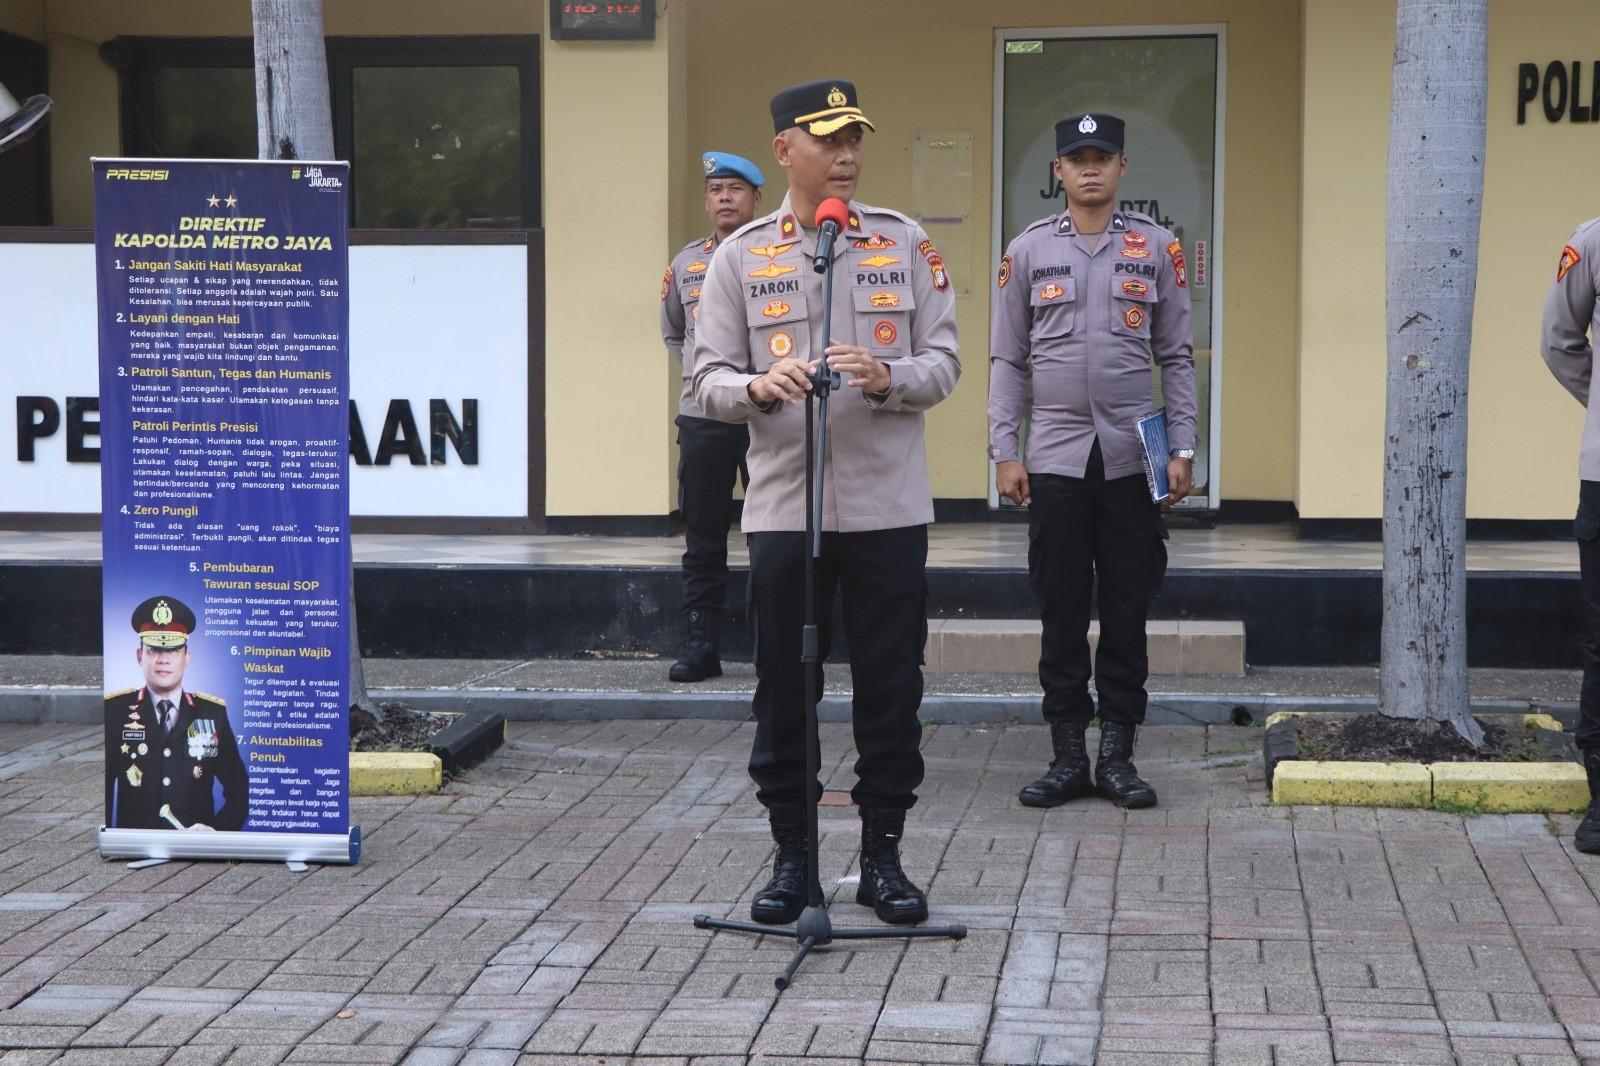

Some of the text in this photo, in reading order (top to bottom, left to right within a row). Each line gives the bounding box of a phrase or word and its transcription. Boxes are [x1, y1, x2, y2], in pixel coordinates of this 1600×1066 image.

[106, 169, 169, 180] PRESISI
[304, 166, 322, 178] JAGA
[179, 216, 266, 231] DIREKTIF
[114, 233, 332, 250] KAPOLDA METRO JAYA
[114, 259, 302, 274] 1. Jangan Sakiti Hati Masyarakat
[1032, 264, 1070, 280] JONATHAN
[1114, 262, 1156, 277] POLRI
[128, 275, 154, 284] Setiap
[205, 276, 226, 285] sikap
[231, 278, 250, 286] yang
[856, 272, 905, 285] POLRI
[176, 287, 202, 296] Setiap
[204, 288, 237, 296] anggota
[269, 288, 293, 297] wajah
[750, 280, 798, 298] ZAROKI
[232, 298, 283, 308] kepercayaan
[116, 312, 239, 326] 2. Layani dengan Hati
[130, 330, 178, 338] Kedepankan
[178, 342, 224, 350] masyarakat
[257, 342, 279, 351] objek
[183, 352, 204, 361] wajib
[224, 353, 255, 362] lindungi
[117, 366, 331, 380] 3. Patroli Santun, Tegas dan Humanis
[242, 385, 288, 394] pendekatan
[271, 397, 313, 406] ketegasan
[316, 398, 339, 406] tanpa
[132, 420, 258, 432] Patroli Perintis Presisi
[305, 438, 339, 447] proaktif-
[174, 458, 198, 467] dialog
[207, 459, 237, 467] dengan
[280, 460, 300, 468] peka
[233, 470, 257, 478] patuhi
[309, 471, 339, 480] Jangan
[133, 479, 208, 487] bertindak/bercanda
[291, 482, 339, 490] kehormatan
[120, 504, 198, 518] 4. Zero Pungli
[317, 535, 339, 544] tegas
[189, 562, 274, 573] 5. Pembubaran
[202, 578, 319, 590] Tawuran sesuai SOP
[230, 645, 331, 659] 6. Pimpinan Wajib
[243, 661, 284, 673] Waskat
[243, 677, 264, 686] Tegur
[266, 678, 297, 687] ditempat
[308, 678, 339, 686] evaluasi
[243, 688, 265, 697] setiap
[314, 689, 339, 697] Tindak
[243, 699, 288, 708] pelanggaran
[293, 700, 314, 708] tanpa
[243, 709, 270, 718] Disiplin
[314, 711, 339, 719] adalah
[236, 734, 323, 747] 7. Akuntabilitas
[250, 751, 285, 762] Penuh
